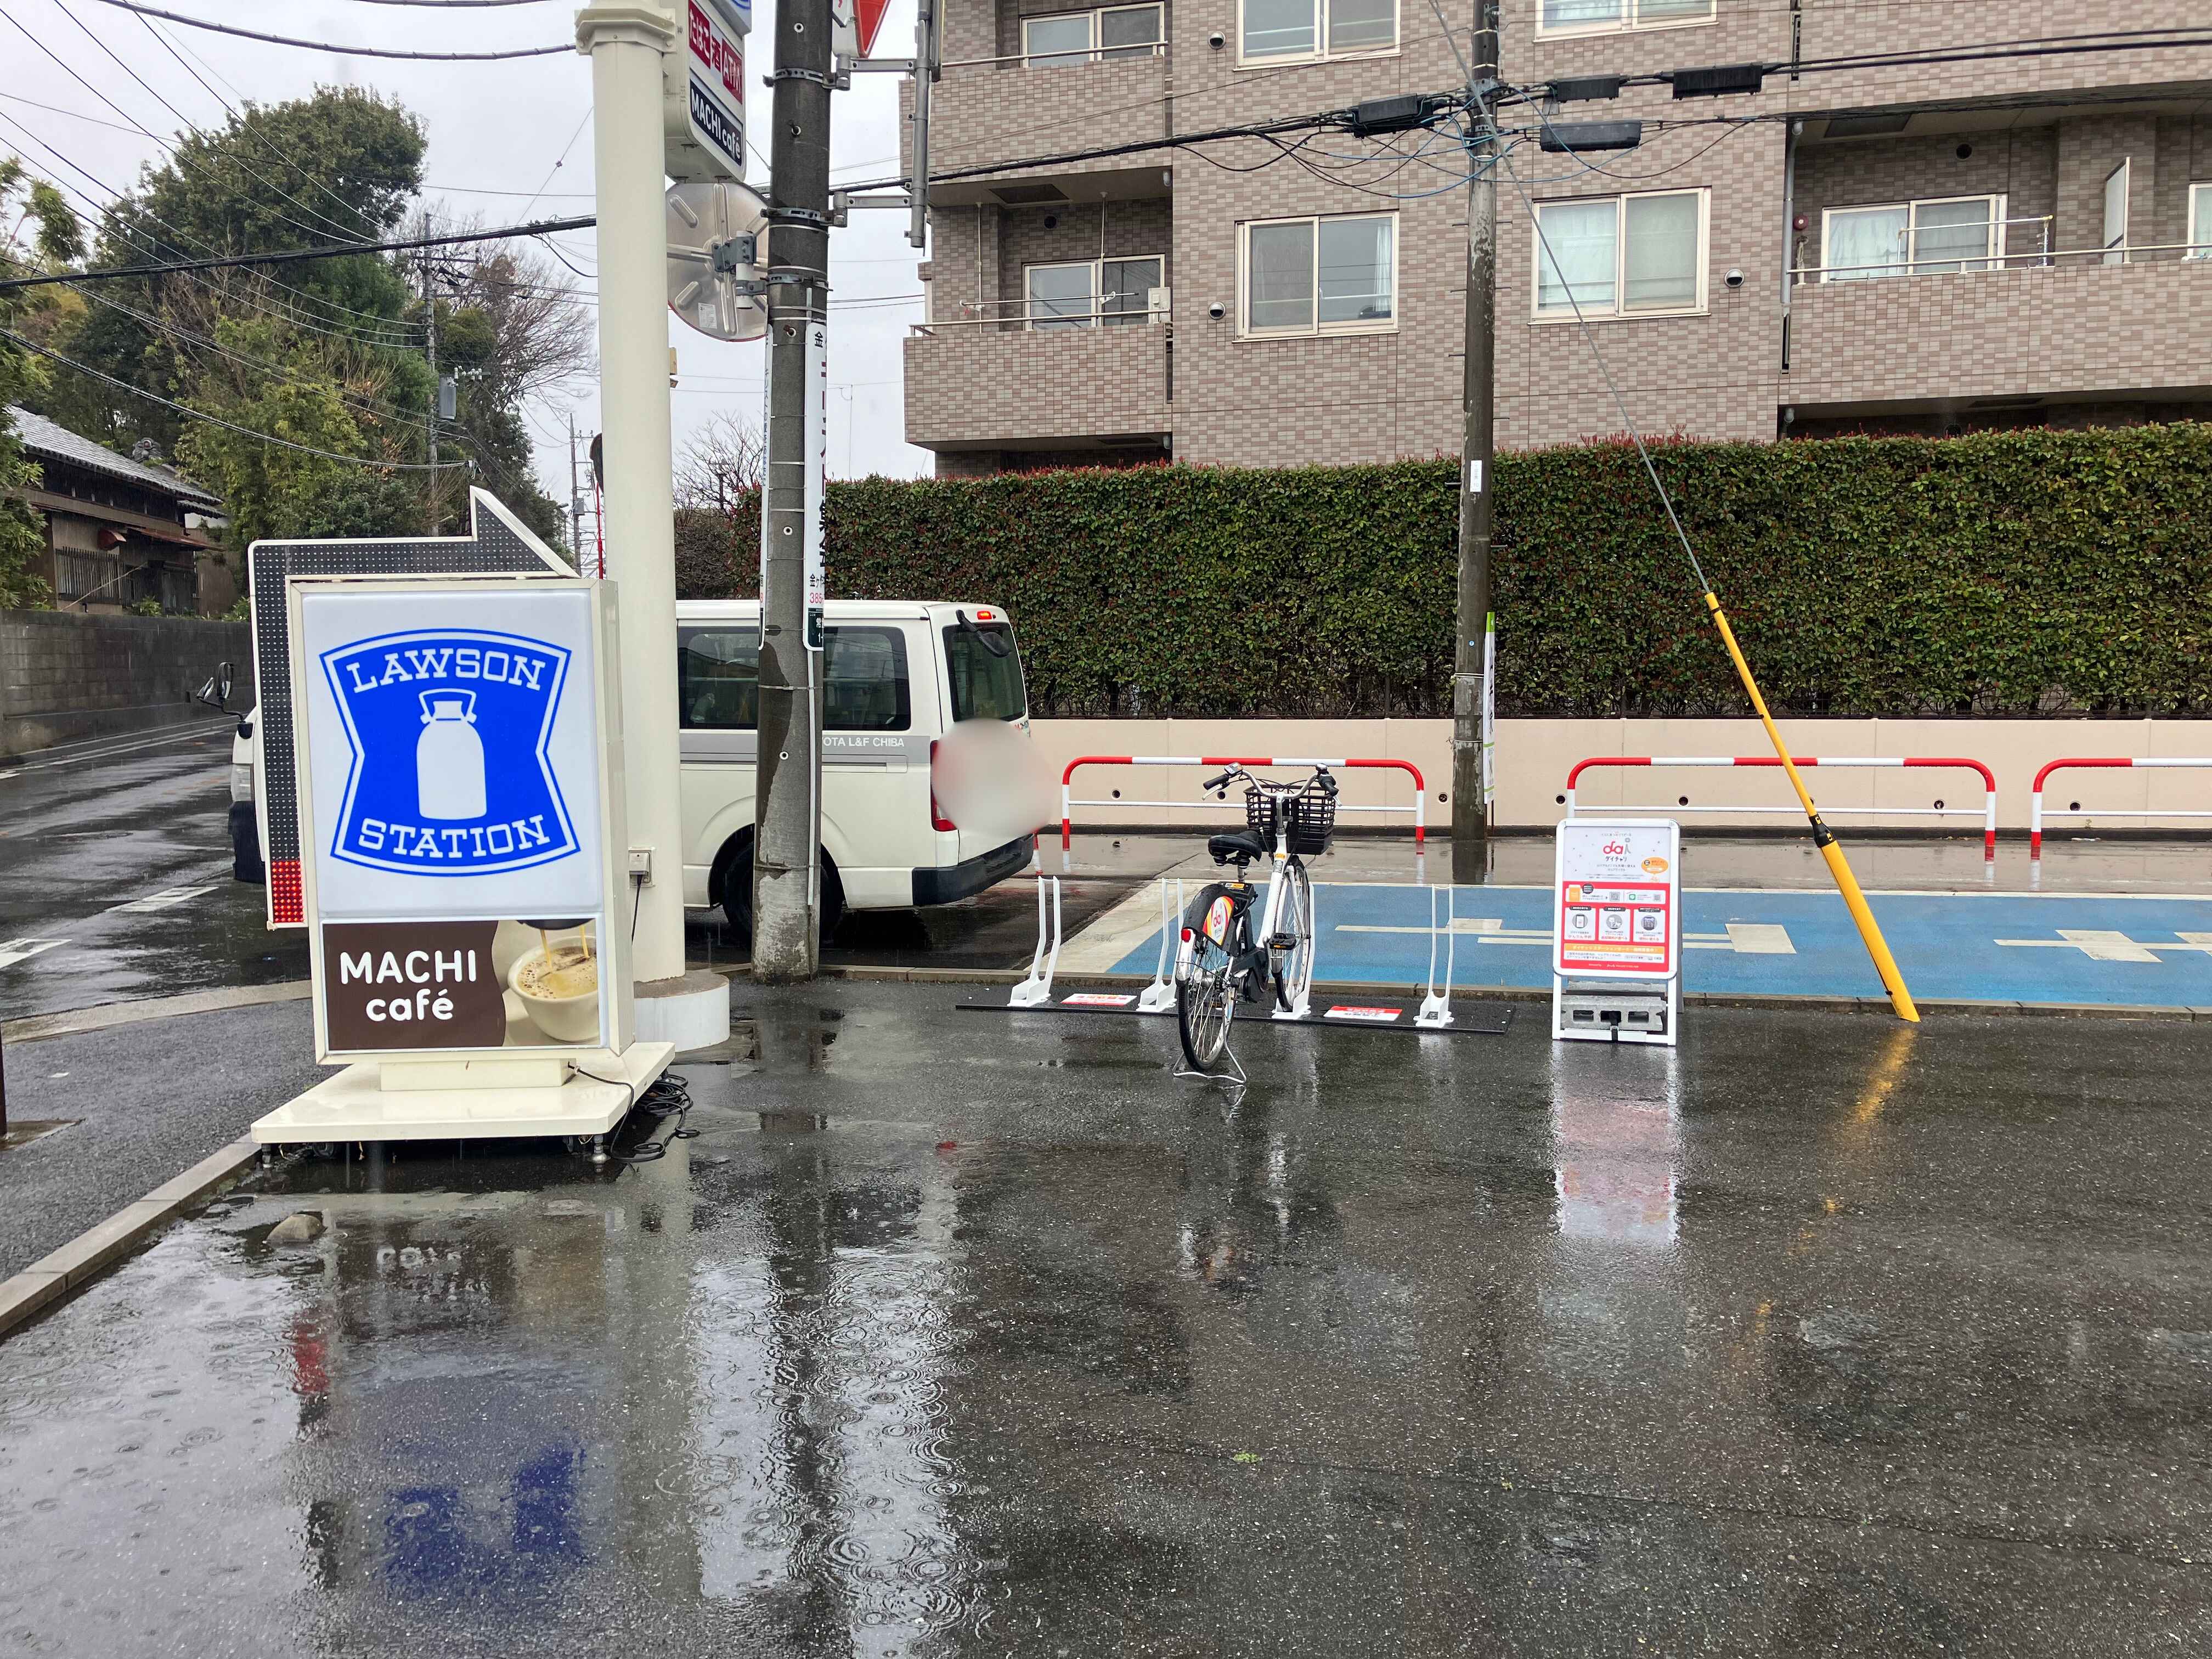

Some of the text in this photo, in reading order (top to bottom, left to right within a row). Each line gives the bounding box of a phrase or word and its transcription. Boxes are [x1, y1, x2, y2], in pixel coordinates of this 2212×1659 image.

[723, 50, 741, 94] ATM
[691, 88, 741, 159] MACHI café
[346, 648, 546, 693] LAWSON
[822, 737, 905, 747] OTA L&F CHIBA
[358, 814, 550, 858] STATION
[340, 950, 477, 984] MACHI
[366, 989, 454, 1022] café
